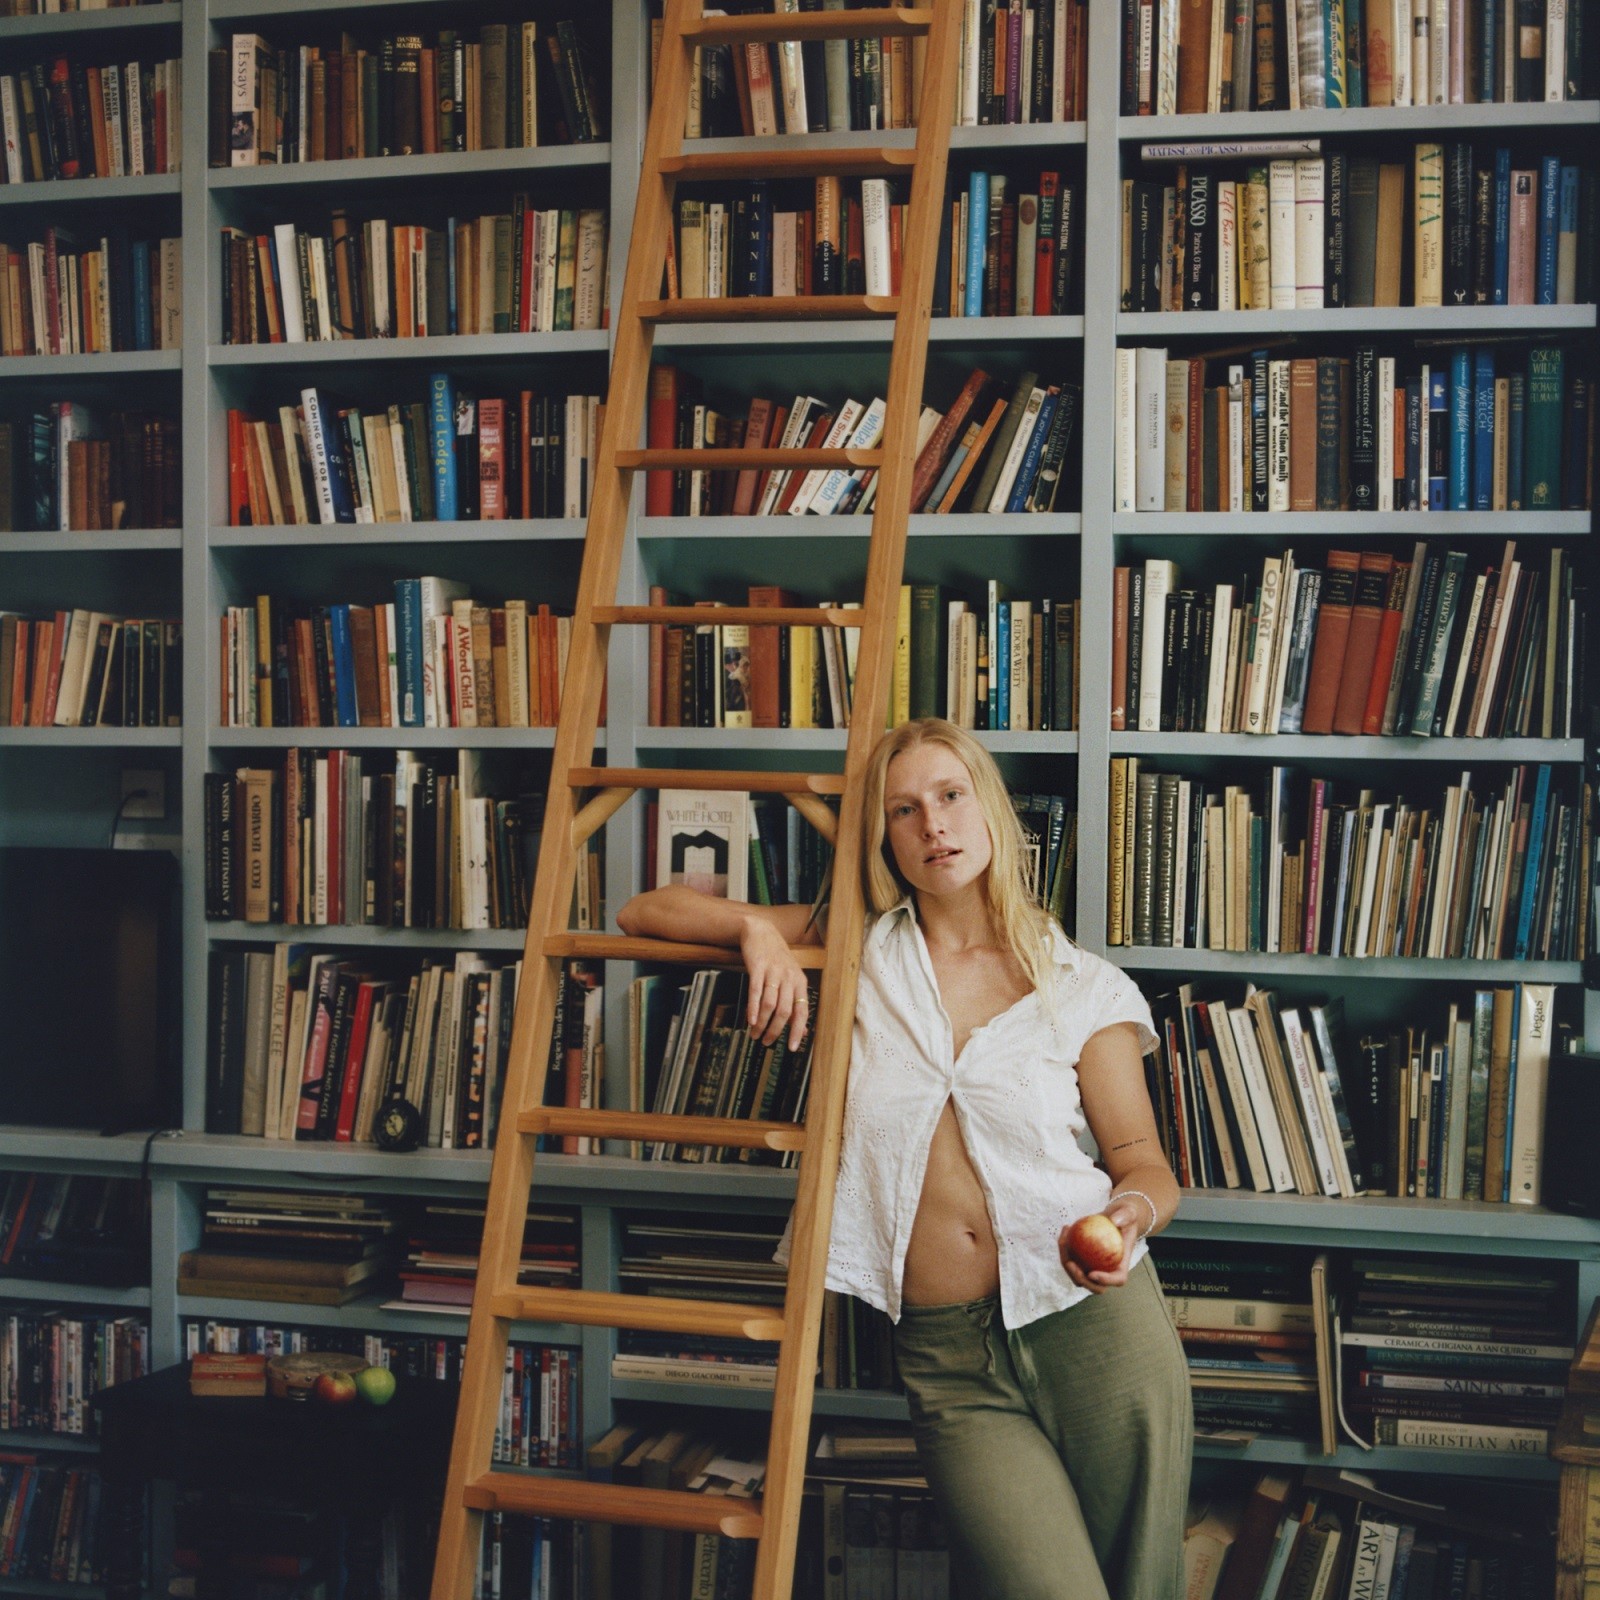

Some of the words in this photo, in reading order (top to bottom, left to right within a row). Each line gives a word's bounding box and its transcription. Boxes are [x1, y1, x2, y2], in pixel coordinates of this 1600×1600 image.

[986, 38, 994, 66] RUMER
[1011, 46, 1019, 55] OF
[129, 70, 138, 100] SILENCE
[233, 52, 250, 97] Essays
[1010, 58, 1018, 89] COTTON
[104, 89, 112, 121] BARKER
[131, 110, 139, 130] GIRLS
[1331, 157, 1341, 187] MARCEL
[1546, 160, 1557, 189] Making
[1190, 176, 1208, 226] PICASSO
[1419, 149, 1442, 227] VITA
[990, 195, 1001, 237] LILA
[1062, 189, 1071, 220] AMERICAN
[1331, 189, 1341, 218] PROUST
[1547, 191, 1556, 218] Trouble
[583, 226, 592, 261] LACUNA
[1060, 221, 1069, 250] PASTORAL
[1193, 232, 1202, 255] Patrick
[1058, 257, 1066, 279] PHILIP
[1193, 257, 1201, 282] O'Brian
[1422, 233, 1430, 280] Glendinning
[1362, 349, 1373, 366] The
[1532, 362, 1558, 373] WILDE
[434, 380, 446, 423] David
[1278, 391, 1288, 406] and
[1362, 370, 1373, 414] Sweetness
[1411, 395, 1418, 406] My
[309, 397, 320, 439] COMING
[1041, 404, 1051, 418] THE
[1278, 408, 1288, 422] the
[1362, 418, 1373, 427] of
[1478, 391, 1486, 428] WELCH
[853, 411, 880, 446] white
[1036, 419, 1047, 432] JOY
[1278, 423, 1288, 454] Ustinov
[1410, 431, 1418, 445] Life
[316, 444, 323, 456] UP
[1030, 431, 1042, 449] LUCK
[1362, 430, 1373, 448] Life
[436, 430, 448, 475] Lodge
[1024, 449, 1036, 468] CLUB
[319, 462, 327, 482] FOR
[1019, 466, 1030, 483] AMY
[1276, 456, 1288, 482] family
[322, 487, 330, 504] AIR
[820, 468, 847, 503] teeth
[1014, 483, 1025, 497] TAN
[402, 583, 411, 595] The
[422, 581, 430, 603] TONI
[1263, 568, 1278, 598] OP
[1422, 557, 1439, 615] IMPRESSIONISM
[1438, 570, 1458, 623] CATALANES
[1481, 584, 1495, 617] TREASURES
[402, 596, 412, 624] Complete
[1182, 602, 1190, 636] Surrealist
[1258, 601, 1274, 639] ART
[1420, 616, 1429, 627] TO
[1479, 618, 1488, 628] OF
[403, 626, 412, 644] Prose
[422, 606, 432, 655] MORRISON
[458, 625, 468, 635] A
[1012, 618, 1021, 656] EUDORA
[1166, 608, 1176, 654] Metaphysical
[1203, 611, 1211, 655] Surrealism
[1432, 625, 1446, 649] ARTE
[459, 637, 471, 673] Word
[1165, 655, 1173, 666] Art
[1256, 648, 1264, 661] Cyril
[1412, 628, 1426, 670] SYMBOLISM
[1429, 649, 1441, 663] DE
[1470, 629, 1486, 674] TUTANKHAMUN
[404, 653, 413, 681] Marianne
[422, 661, 436, 696] Love
[1012, 657, 1021, 688] WELTY
[1254, 663, 1262, 683] Barrett
[461, 675, 473, 709] Child
[1421, 664, 1438, 702] MUSEOS
[694, 801, 708, 810] THE
[1126, 796, 1134, 808] AGE
[1126, 809, 1133, 819] OF
[1142, 795, 1153, 820] THE
[1163, 797, 1173, 821] THE
[250, 794, 261, 852] LEONARDO
[667, 810, 700, 822] WHITE
[701, 810, 734, 823] HOTEL
[222, 829, 229, 841] DA
[1140, 822, 1152, 845] ART
[1161, 824, 1172, 847] ART
[1140, 848, 1151, 863] OF
[1160, 849, 1172, 864] OF
[250, 859, 261, 888] ECCO
[1139, 864, 1151, 887] THE
[1159, 865, 1171, 889] THE
[1138, 887, 1150, 916] WEST
[1159, 889, 1171, 918] WEST
[272, 984, 285, 1017] PAUL
[335, 985, 346, 1007] PAUL
[331, 1008, 342, 1029] KLEE
[1528, 999, 1545, 1039] Degas
[271, 1023, 284, 1056] KLEE
[326, 1033, 339, 1068] FIGURES
[580, 1024, 591, 1071] Jheronimus
[1369, 1054, 1378, 1072] van
[323, 1069, 334, 1092] AND
[579, 1073, 589, 1099] Bosch
[1369, 1076, 1378, 1103] Gogh
[318, 1092, 330, 1121] FACES
[1384, 1338, 1429, 1349] CERAMICA
[1431, 1341, 1473, 1352] CHIGIANA
[1500, 1346, 1537, 1356] QUIRICO
[665, 1369, 689, 1378] DIEGO
[691, 1370, 740, 1381] GIACOMETTI
[1443, 1379, 1504, 1394] SAINTS
[1403, 1432, 1497, 1450] CHRISTIAN
[1507, 1438, 1541, 1452] ART
[1360, 1526, 1380, 1566] ART
[1358, 1565, 1366, 1576] AT
[1451, 1557, 1464, 1583] THE
